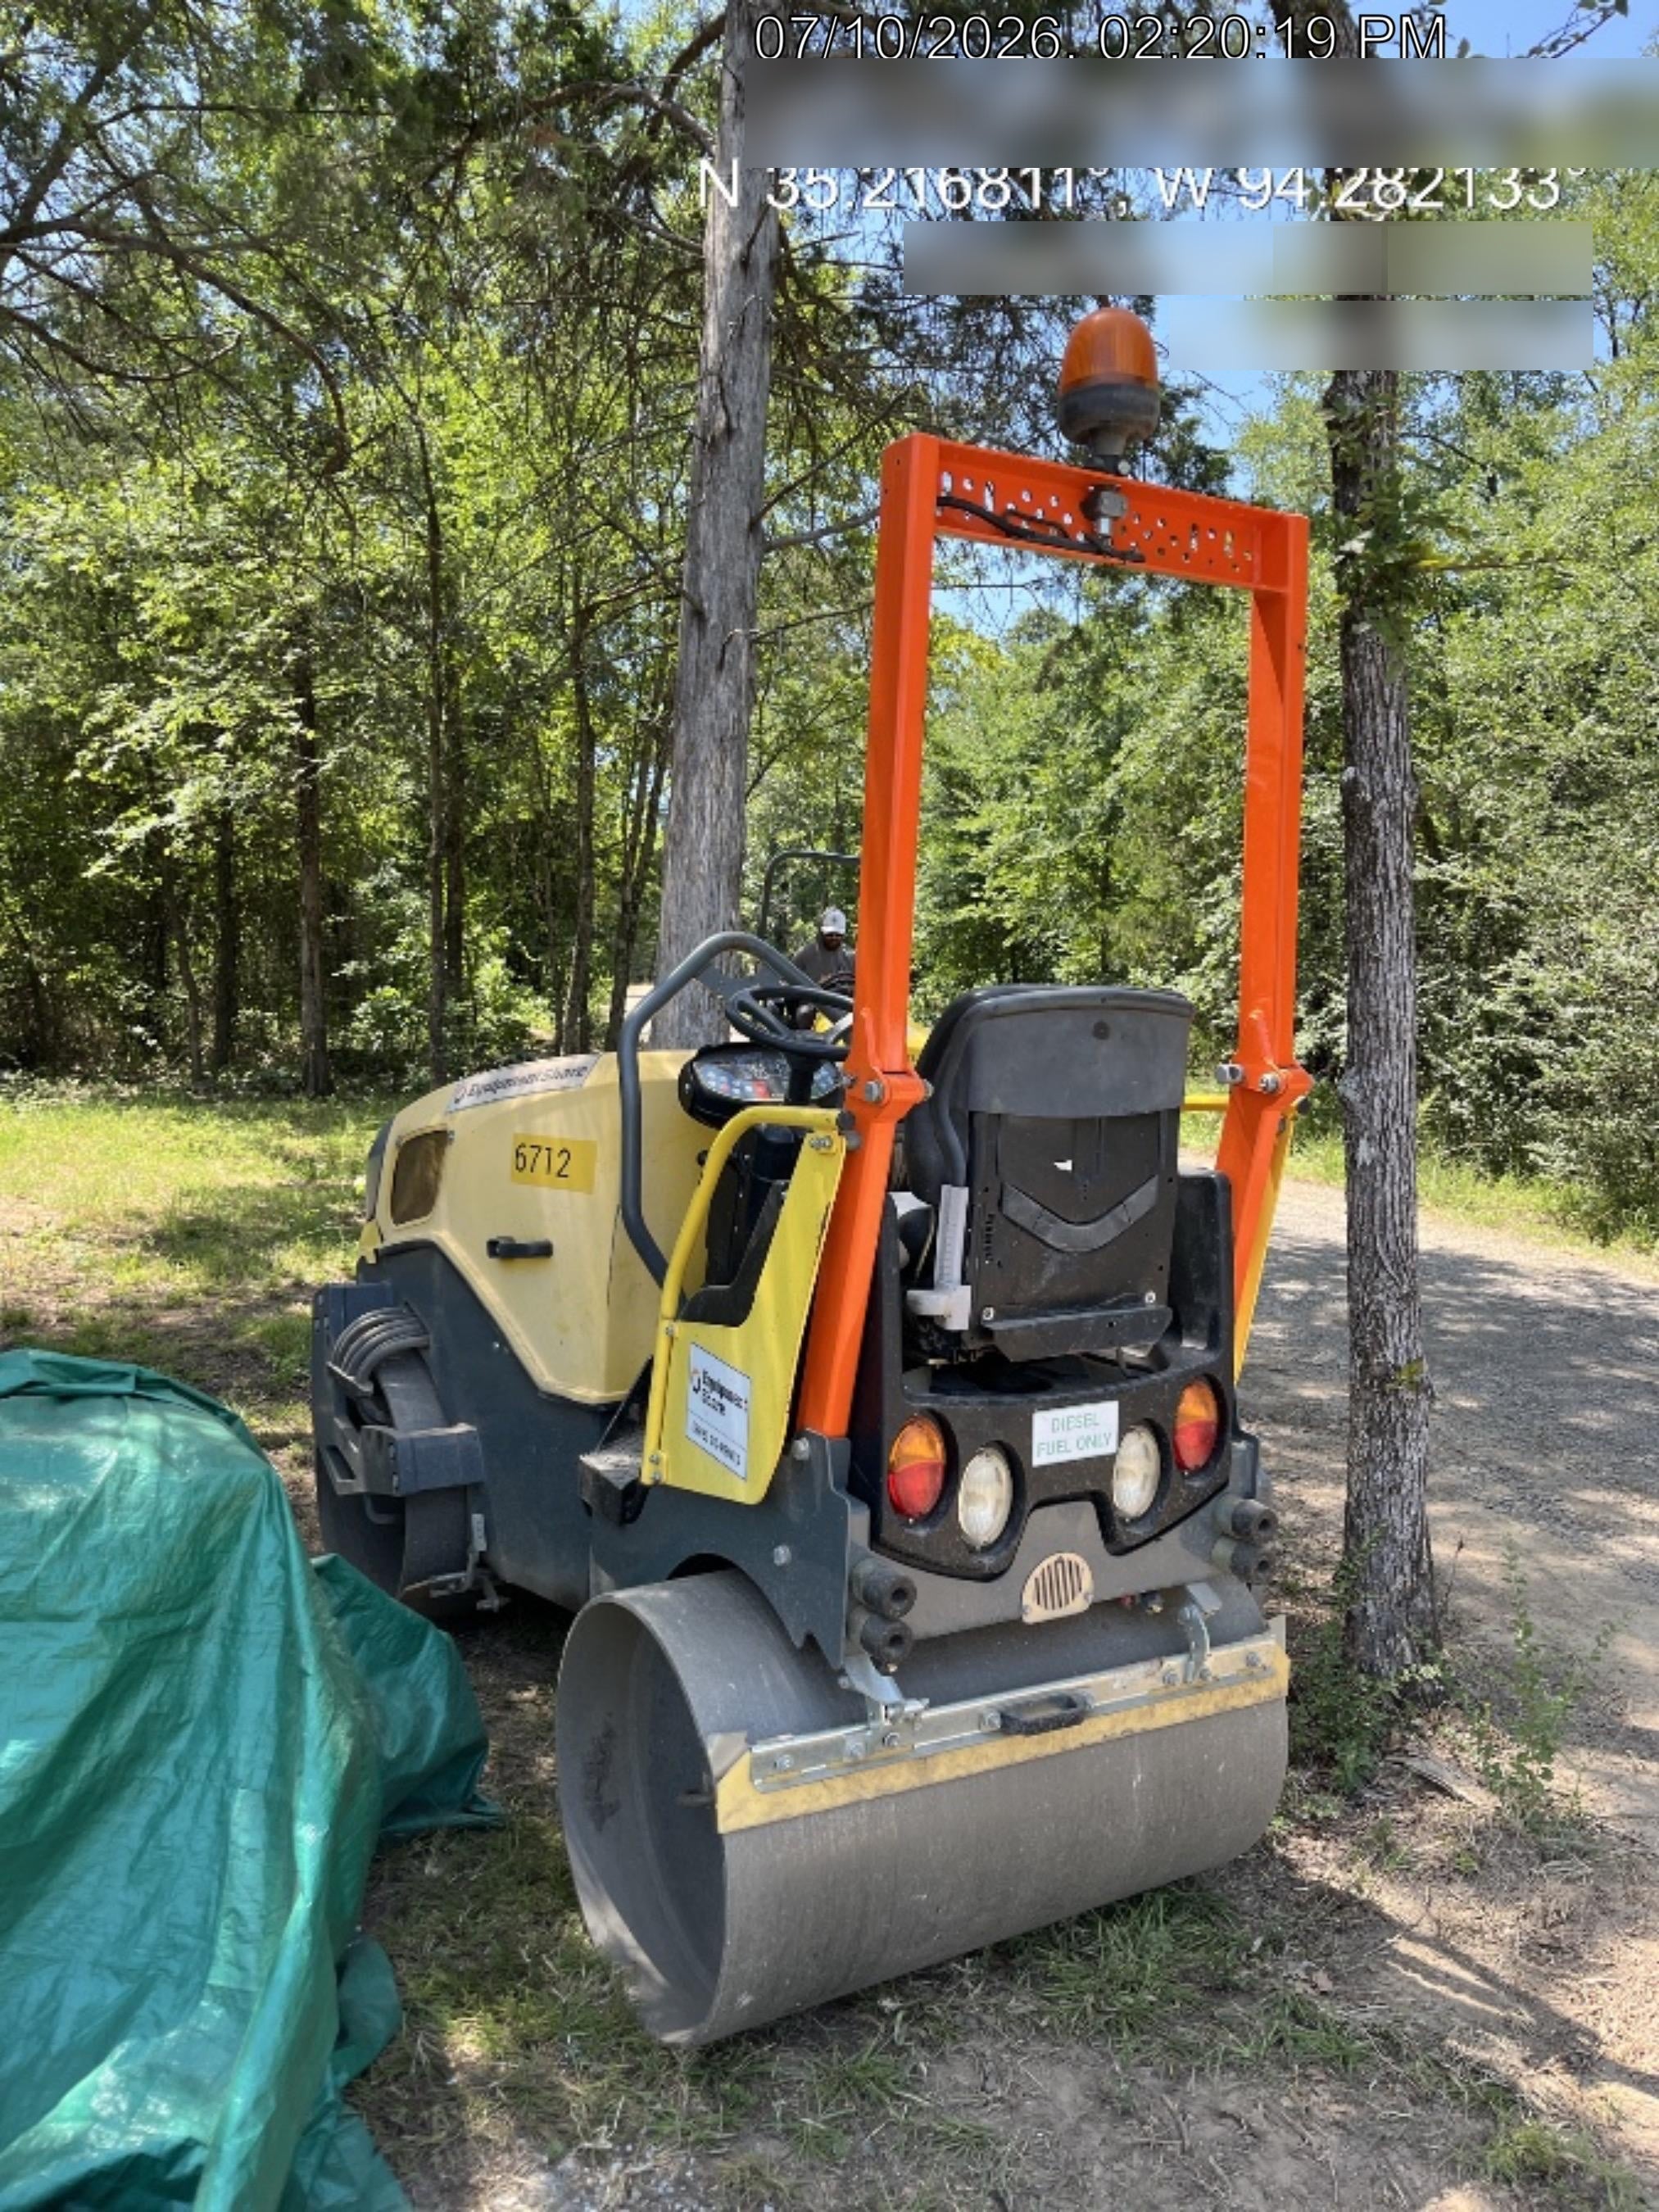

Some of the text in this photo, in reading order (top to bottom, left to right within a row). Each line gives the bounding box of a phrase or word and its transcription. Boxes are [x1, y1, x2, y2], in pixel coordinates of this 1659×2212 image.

[514, 1142, 572, 1178] 6712
[1050, 1412, 1100, 1434] DIESEL
[1036, 1431, 1113, 1458] FUEL ONLY
